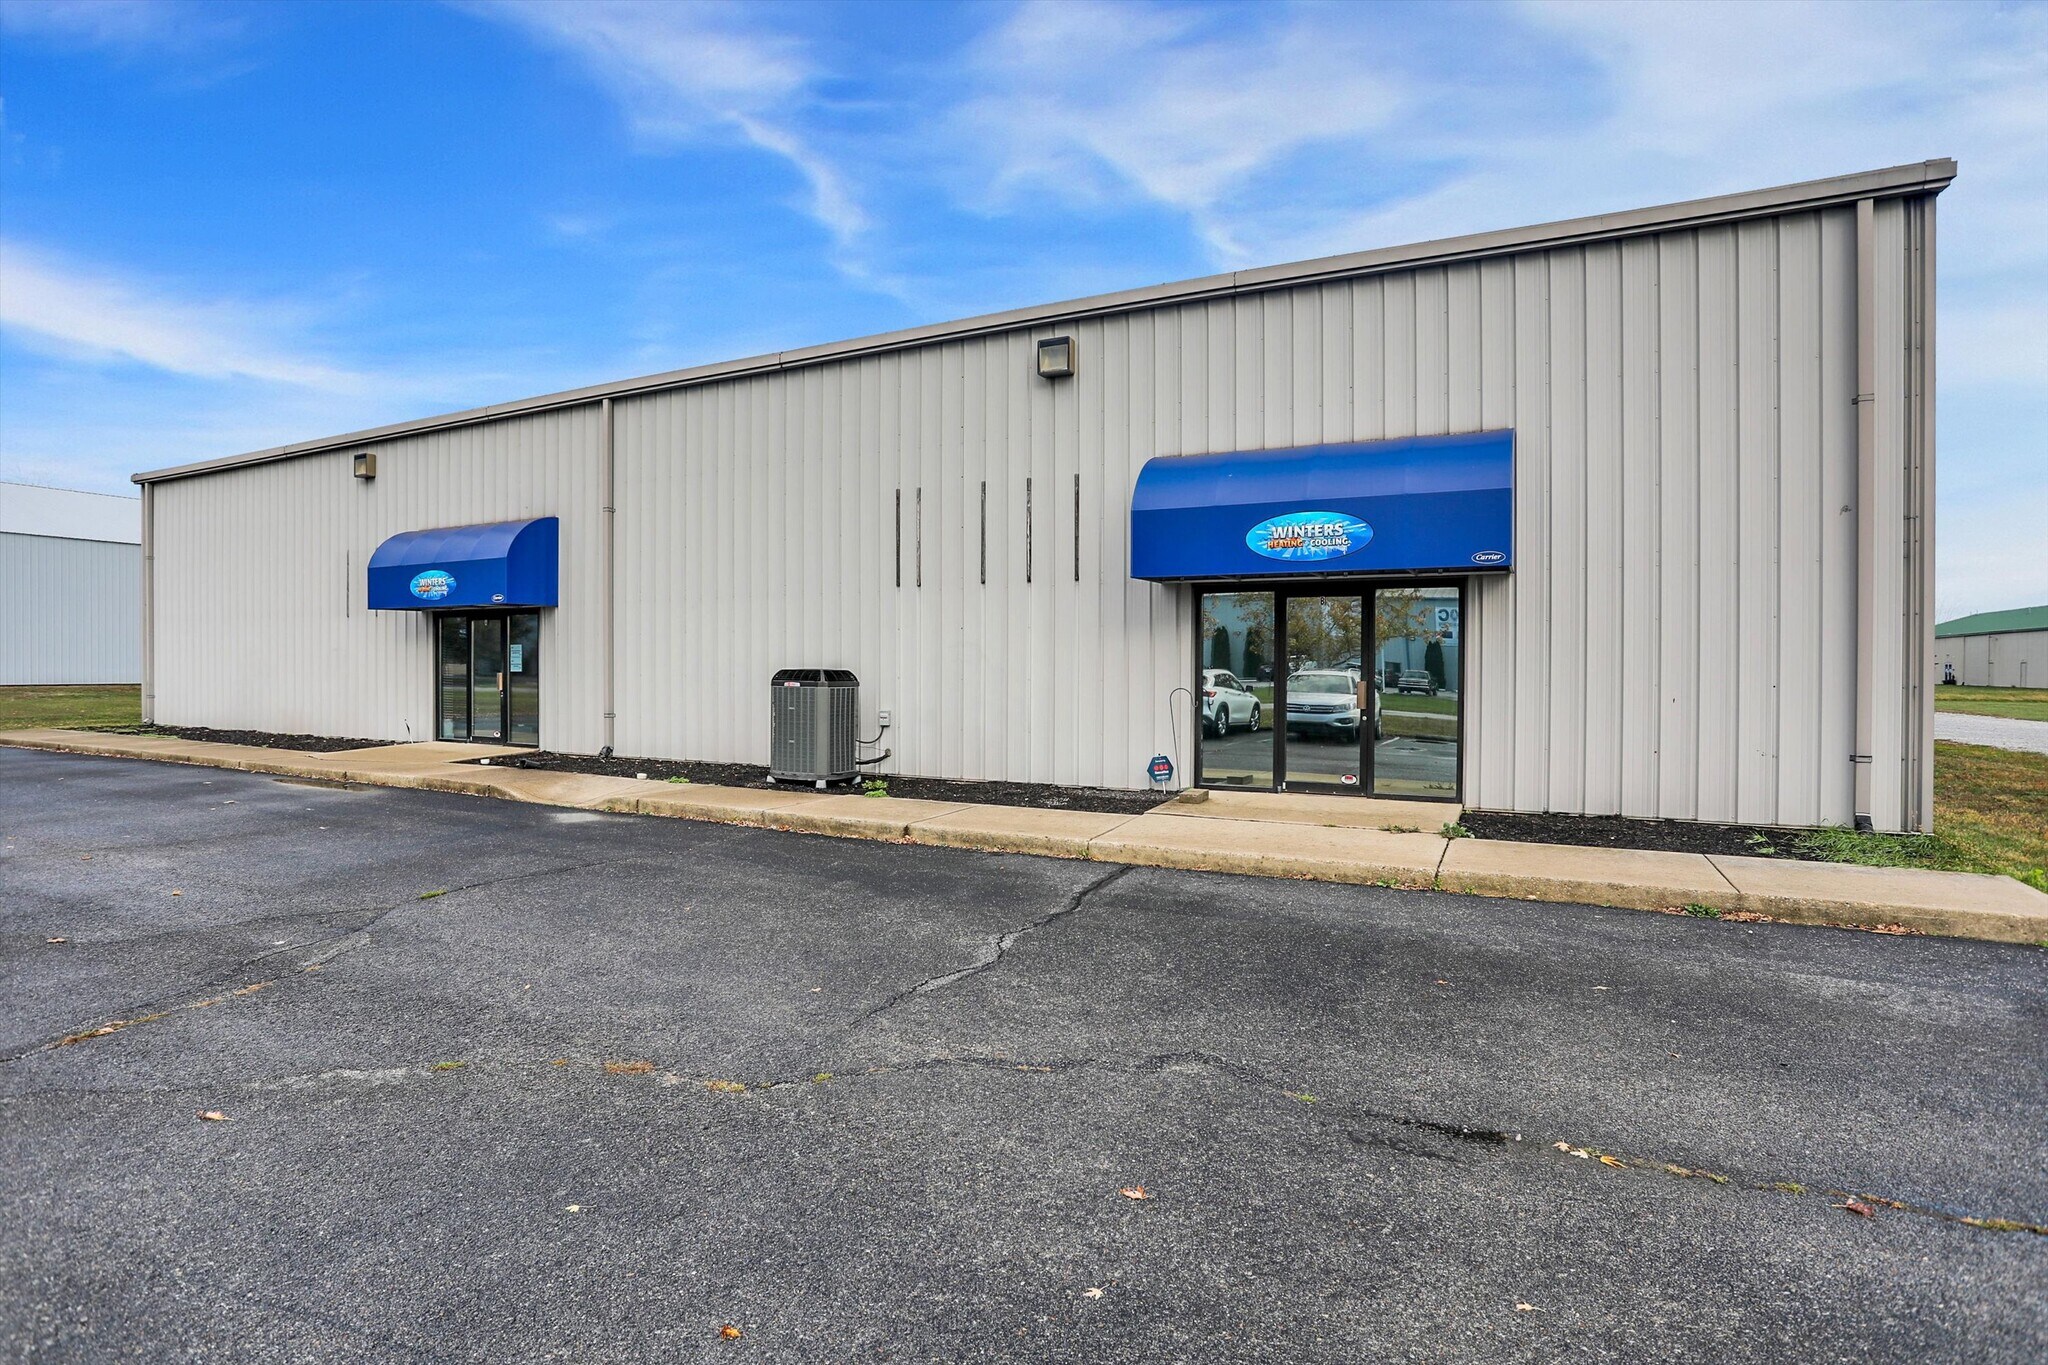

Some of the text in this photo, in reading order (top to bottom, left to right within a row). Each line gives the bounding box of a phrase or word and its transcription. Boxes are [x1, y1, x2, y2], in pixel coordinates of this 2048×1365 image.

[1272, 523, 1345, 538] WINTERS
[1267, 538, 1349, 549] HEATING COOLING
[419, 578, 446, 586] WINTERS
